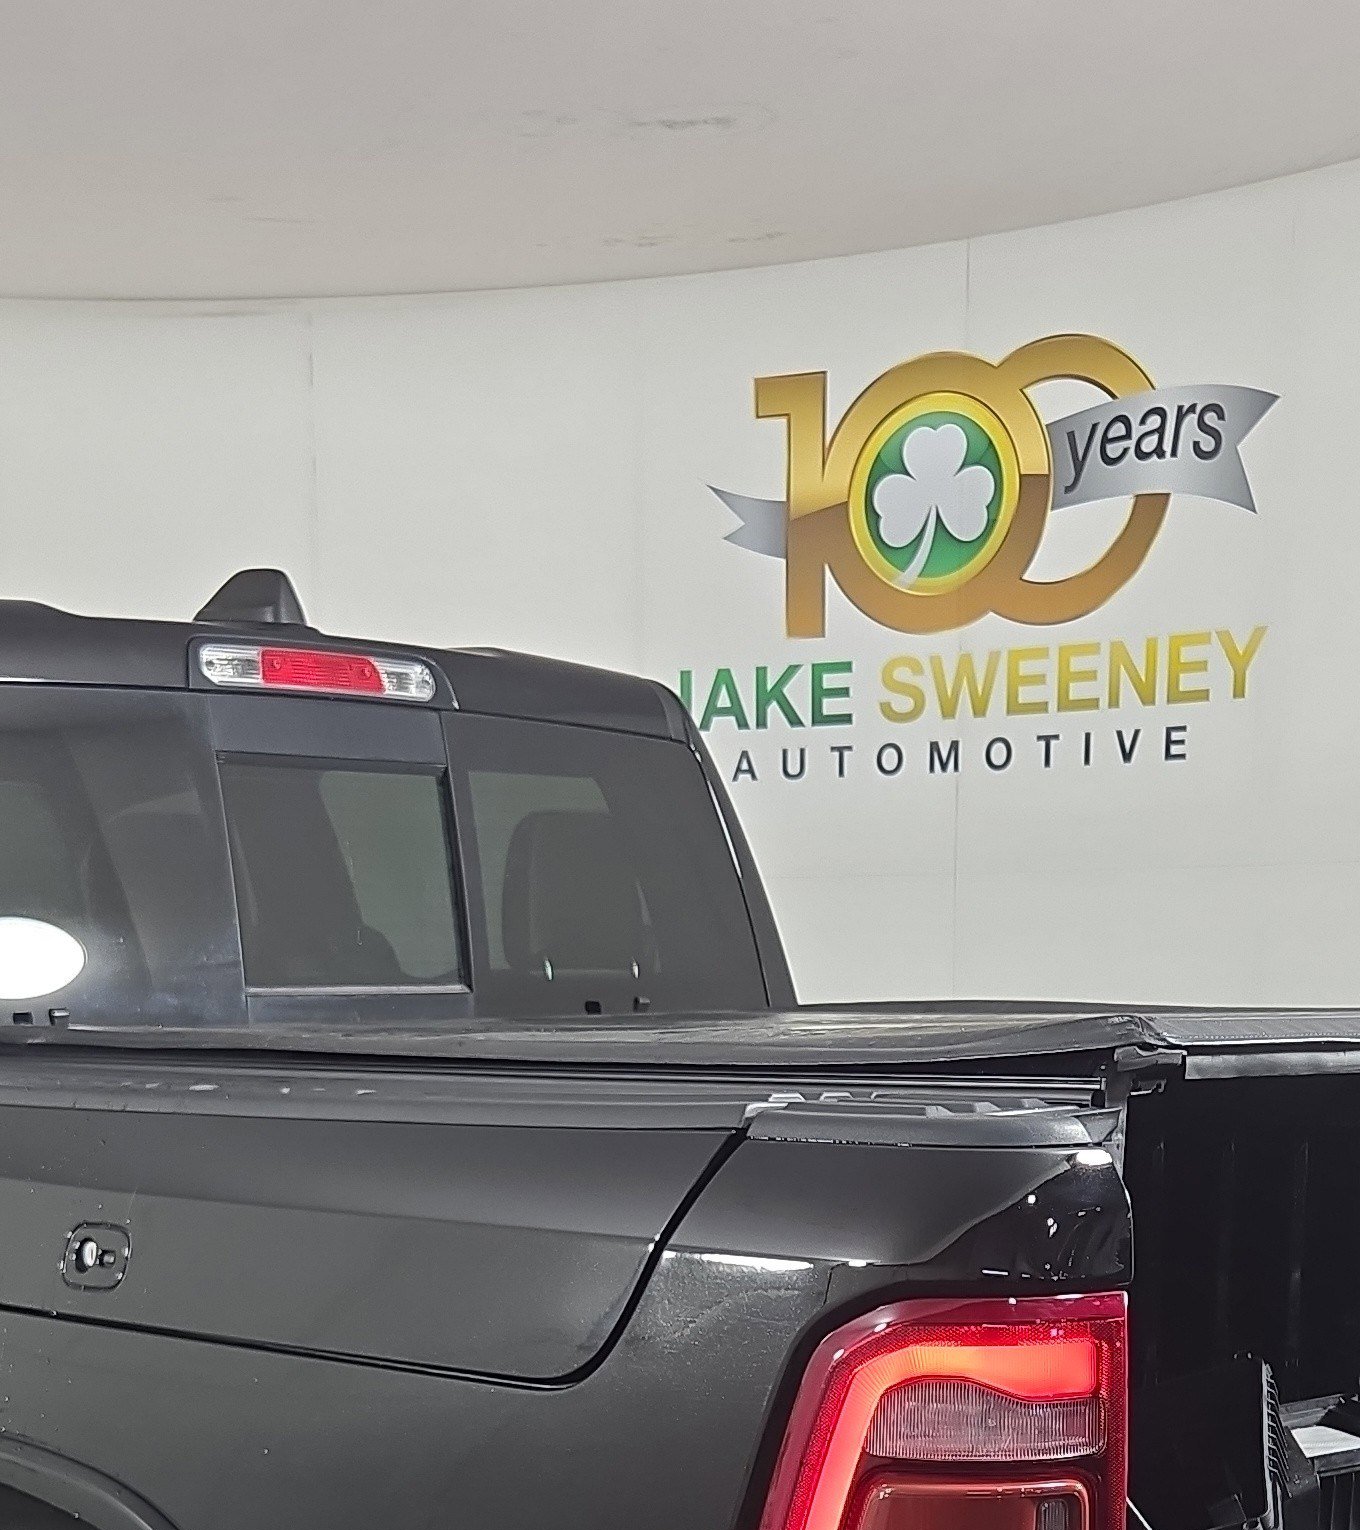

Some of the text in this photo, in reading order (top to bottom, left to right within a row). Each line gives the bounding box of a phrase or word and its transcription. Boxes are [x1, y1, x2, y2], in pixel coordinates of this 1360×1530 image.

[1063, 401, 1227, 495] years
[879, 625, 1268, 725] SWEENEY
[732, 724, 1188, 783] AUTOMOTIVE
